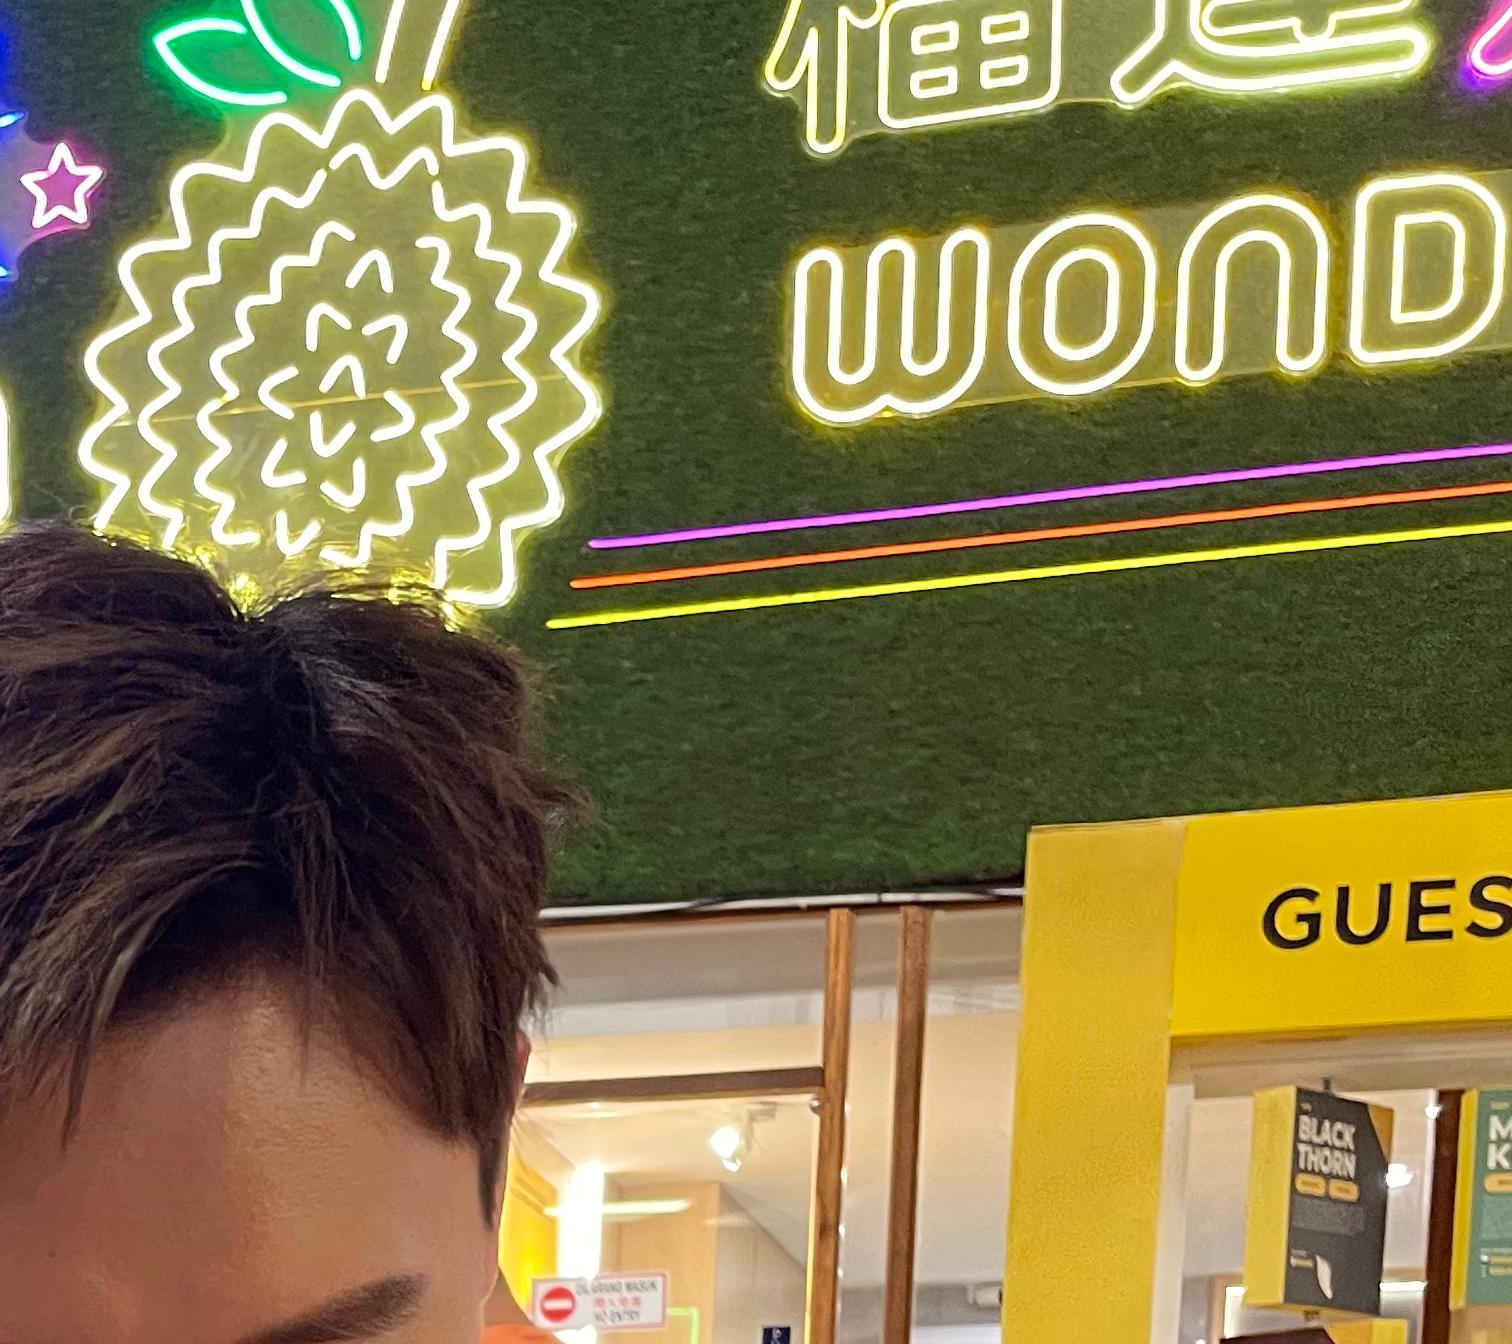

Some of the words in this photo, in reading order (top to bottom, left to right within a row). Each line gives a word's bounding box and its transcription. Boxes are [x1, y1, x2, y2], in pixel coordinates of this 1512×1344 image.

[1262, 876, 1512, 950] GUES
[1299, 1115, 1356, 1150] BLACK
[1297, 1142, 1356, 1179] THORN
